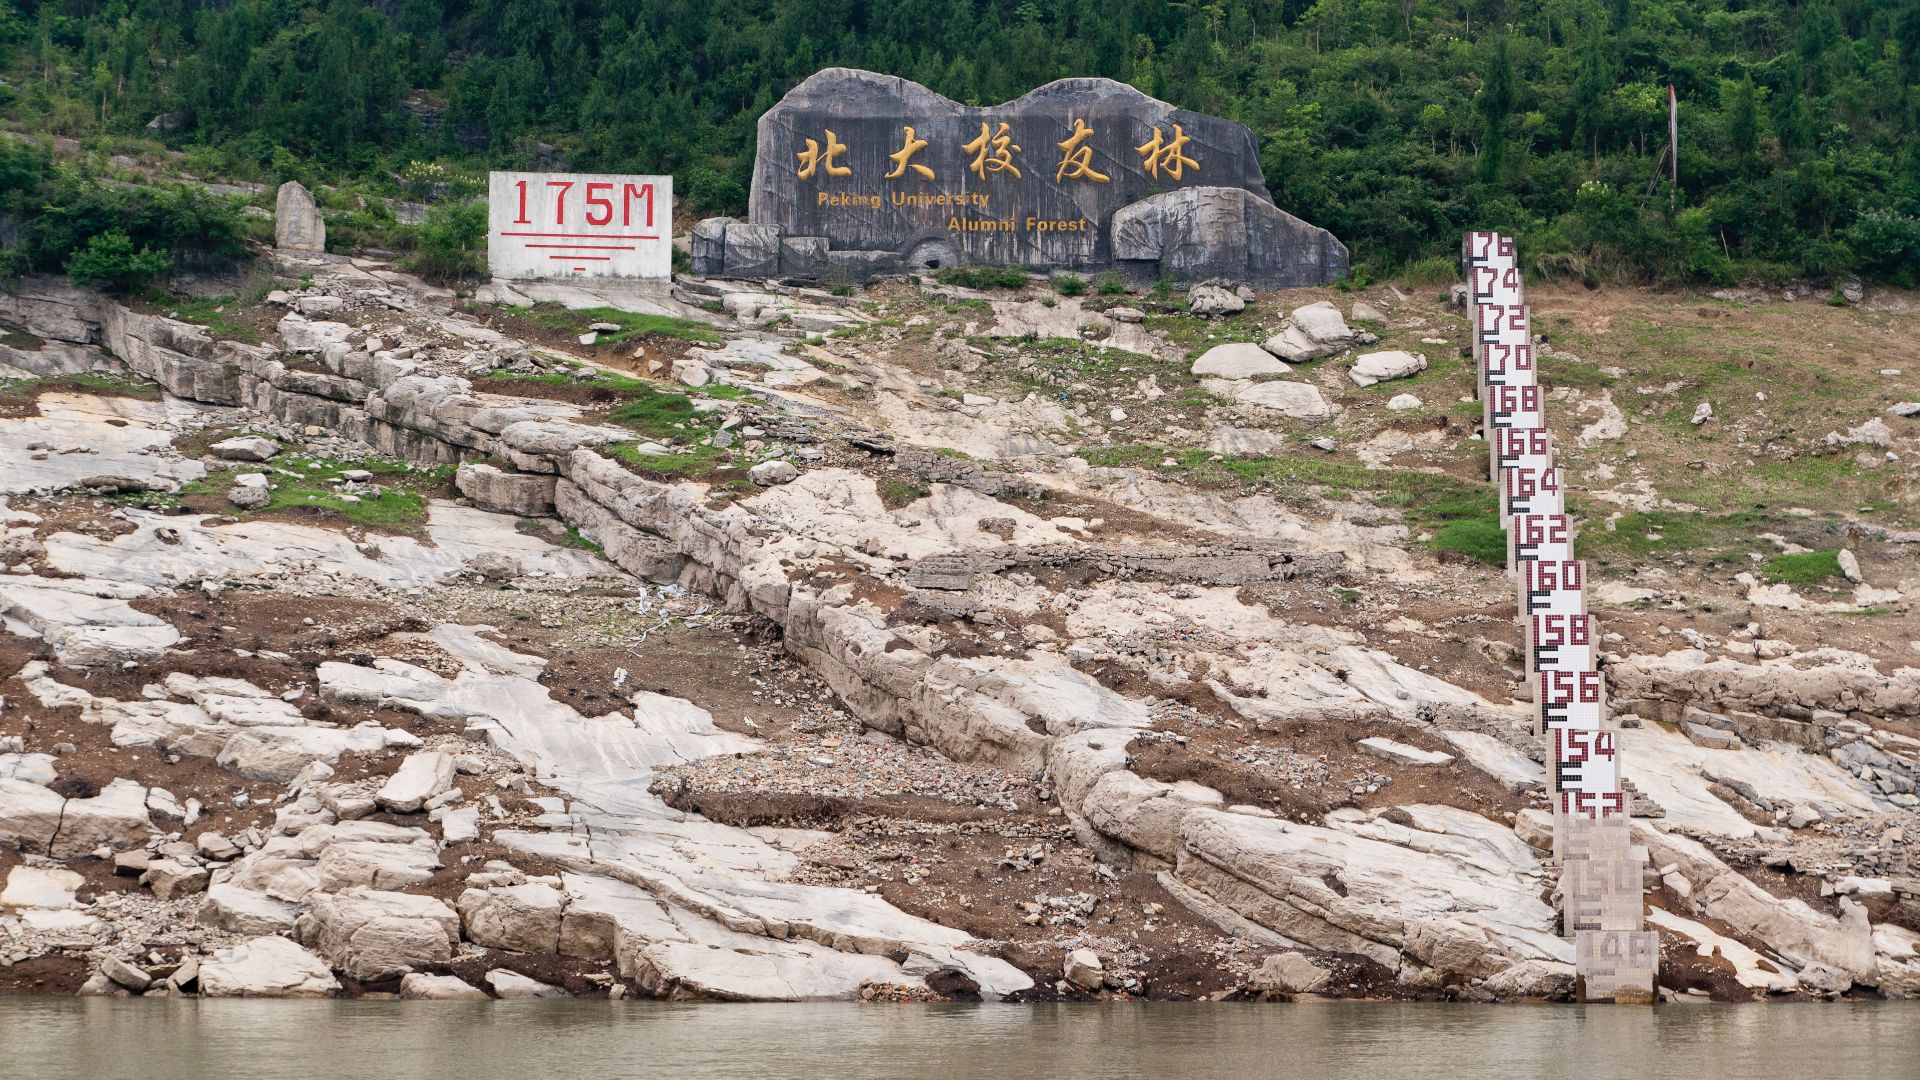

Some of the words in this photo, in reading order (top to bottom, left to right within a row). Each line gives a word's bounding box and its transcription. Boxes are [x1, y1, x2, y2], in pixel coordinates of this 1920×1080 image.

[797, 118, 1200, 184] 北大校友林
[513, 180, 654, 227] 175M
[818, 191, 881, 208] Peking
[891, 191, 990, 207] University
[948, 216, 1017, 232] Alumni
[1026, 216, 1087, 232] Forest
[1466, 232, 1513, 257] 176
[1472, 268, 1518, 294] 174
[1479, 305, 1525, 331] 172
[1484, 345, 1531, 371] 170
[1490, 386, 1538, 412] 168
[1497, 428, 1547, 456] 166
[1507, 468, 1558, 496] 164
[1515, 515, 1567, 544] 162
[1526, 561, 1581, 591] 160
[1533, 615, 1589, 645] 158
[1542, 671, 1599, 703] 156
[1555, 729, 1615, 762] 154
